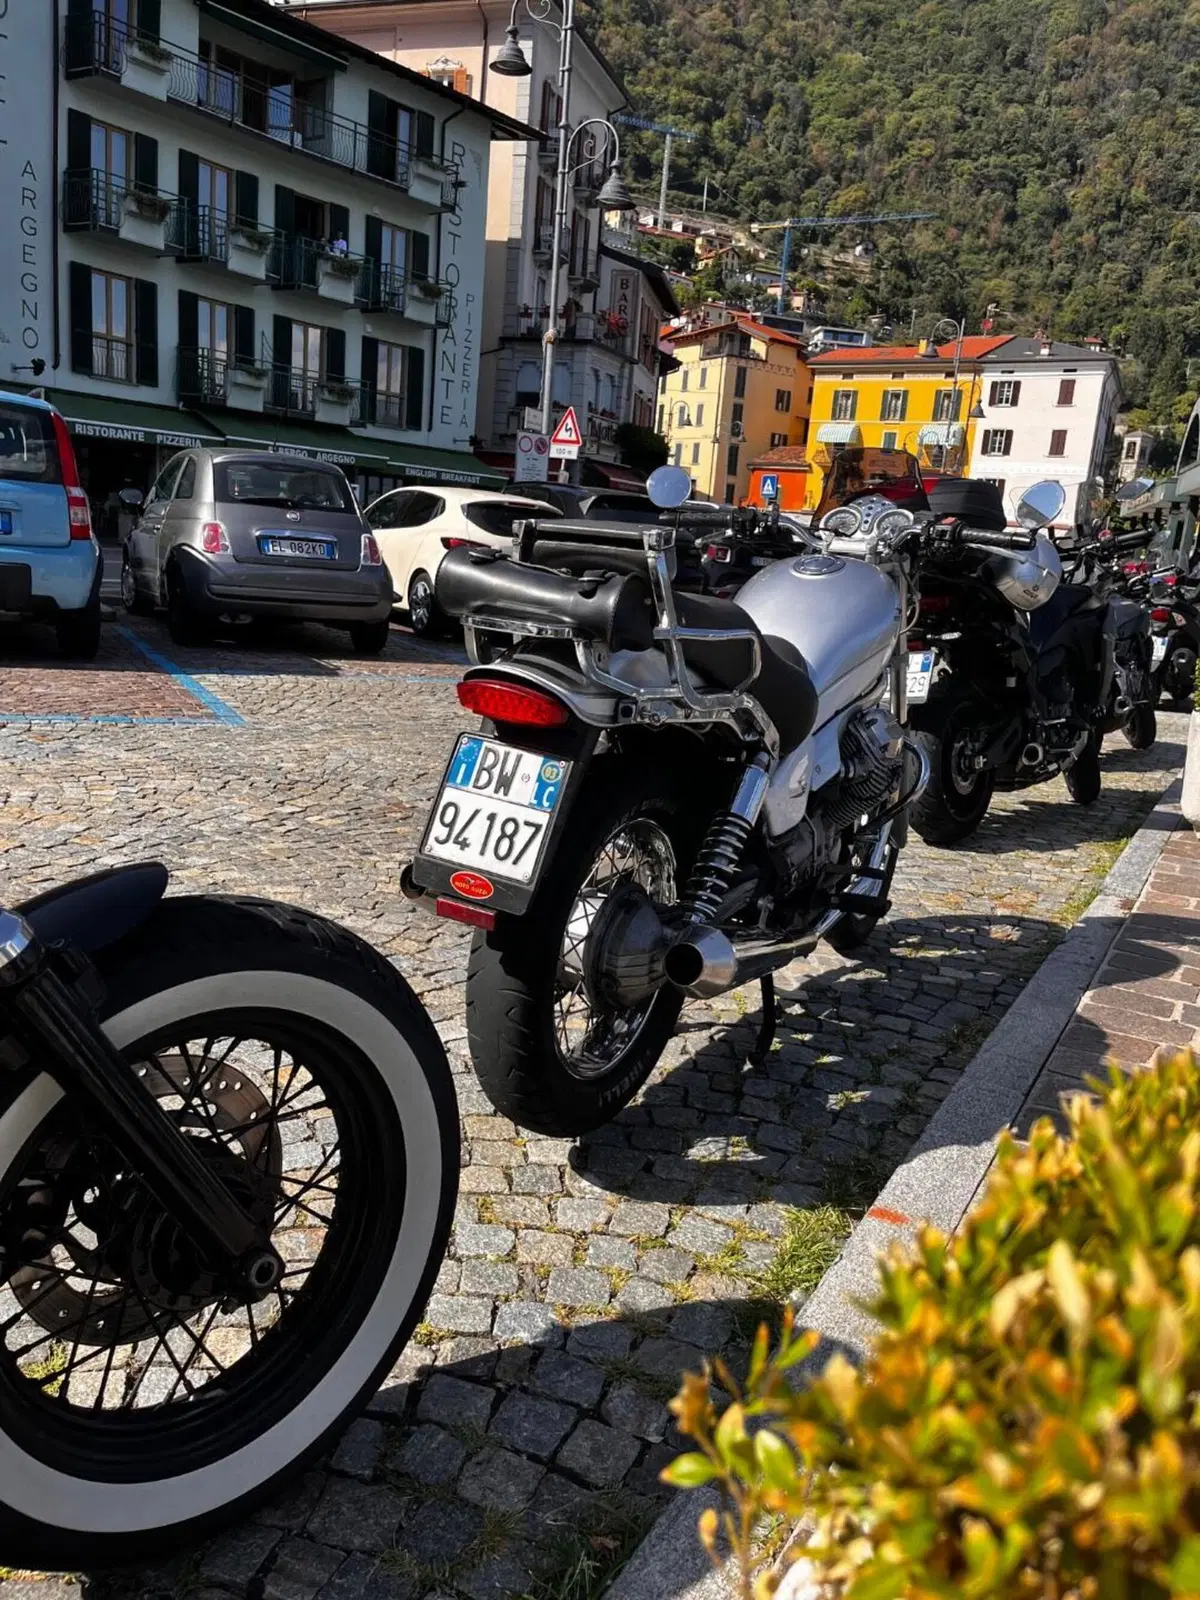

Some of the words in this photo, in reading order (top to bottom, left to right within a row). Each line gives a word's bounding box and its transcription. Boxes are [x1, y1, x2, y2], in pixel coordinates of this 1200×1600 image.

[20, 159, 40, 349] ARGEGNO
[440, 141, 466, 425] RSTORANTE
[618, 278, 629, 316] BAR
[459, 293, 475, 428] PIZZERIA
[75, 423, 145, 442] RISTORANTE
[156, 434, 202, 449] PIZZERIA
[315, 451, 356, 464] ARGEGNO
[405, 467, 437, 479] ENGLISH
[441, 471, 480, 485] BREAKFAST
[271, 540, 286, 553] EL
[472, 747, 523, 797] BW
[531, 781, 555, 808] LC
[434, 801, 543, 866] 94187
